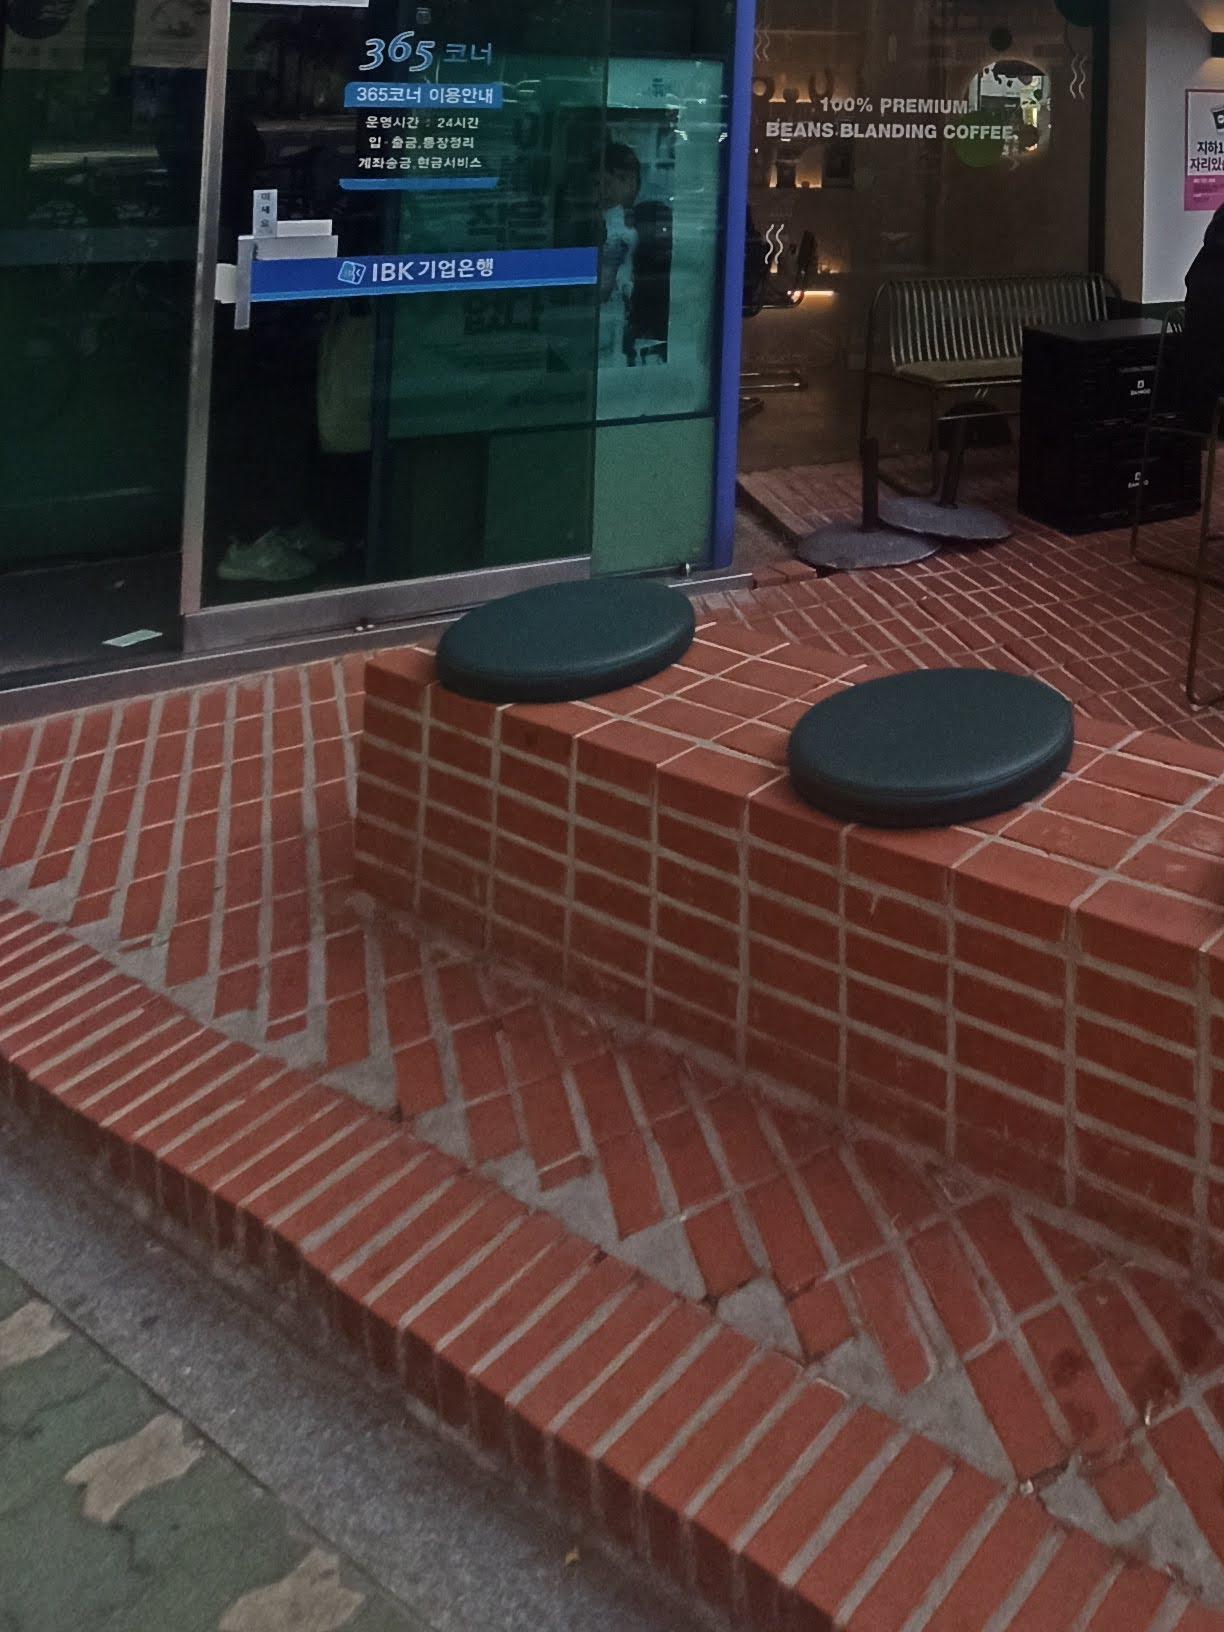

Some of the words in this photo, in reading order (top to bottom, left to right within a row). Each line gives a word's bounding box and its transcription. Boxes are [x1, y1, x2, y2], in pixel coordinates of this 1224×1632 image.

[358, 31, 436, 72] 365
[443, 42, 492, 66] 코너
[356, 86, 422, 103] 365코너
[429, 87, 494, 105] 이용안내
[820, 96, 873, 113] 100%
[881, 98, 968, 115] PREMIUM
[365, 116, 420, 129] 운영시간
[436, 117, 479, 129] 24시간
[766, 121, 834, 139] BEANS
[840, 121, 937, 140] BLANDING
